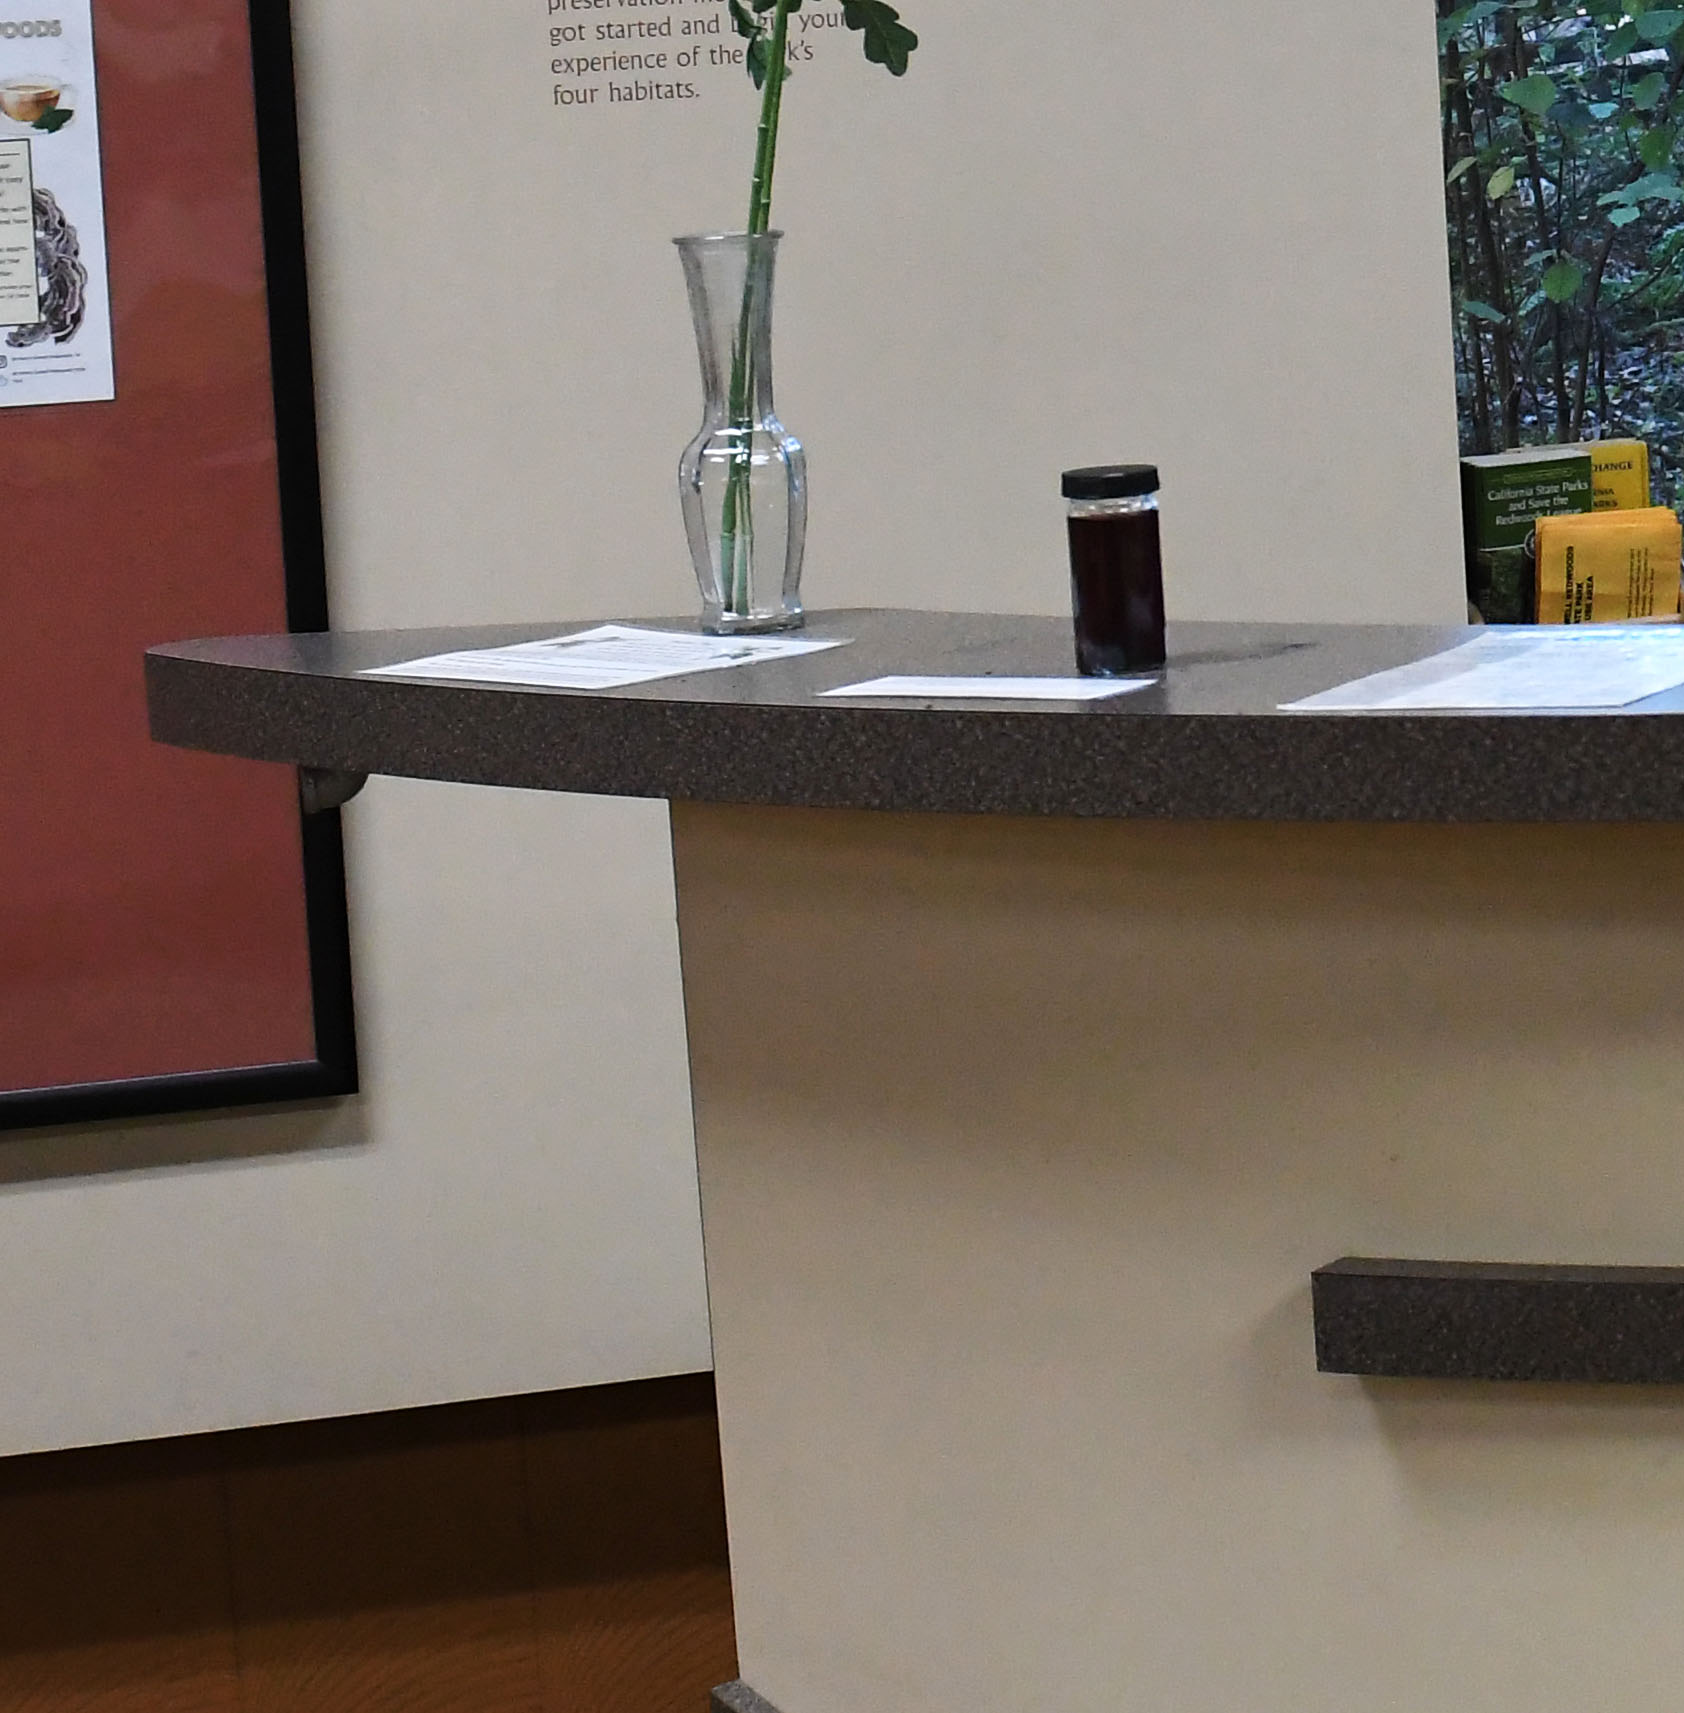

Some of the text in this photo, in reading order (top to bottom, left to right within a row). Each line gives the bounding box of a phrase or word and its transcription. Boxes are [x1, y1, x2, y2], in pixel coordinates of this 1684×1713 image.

[549, 23, 586, 47] got
[595, 15, 672, 42] started
[681, 12, 721, 36] and
[551, 48, 668, 77] experience
[676, 45, 701, 69] of
[709, 44, 744, 66] the
[552, 80, 701, 106] four habitats.
[1488, 488, 1534, 501] California
[1562, 479, 1589, 492] Parks
[1508, 499, 1527, 511] and
[1553, 494, 1569, 506] the
